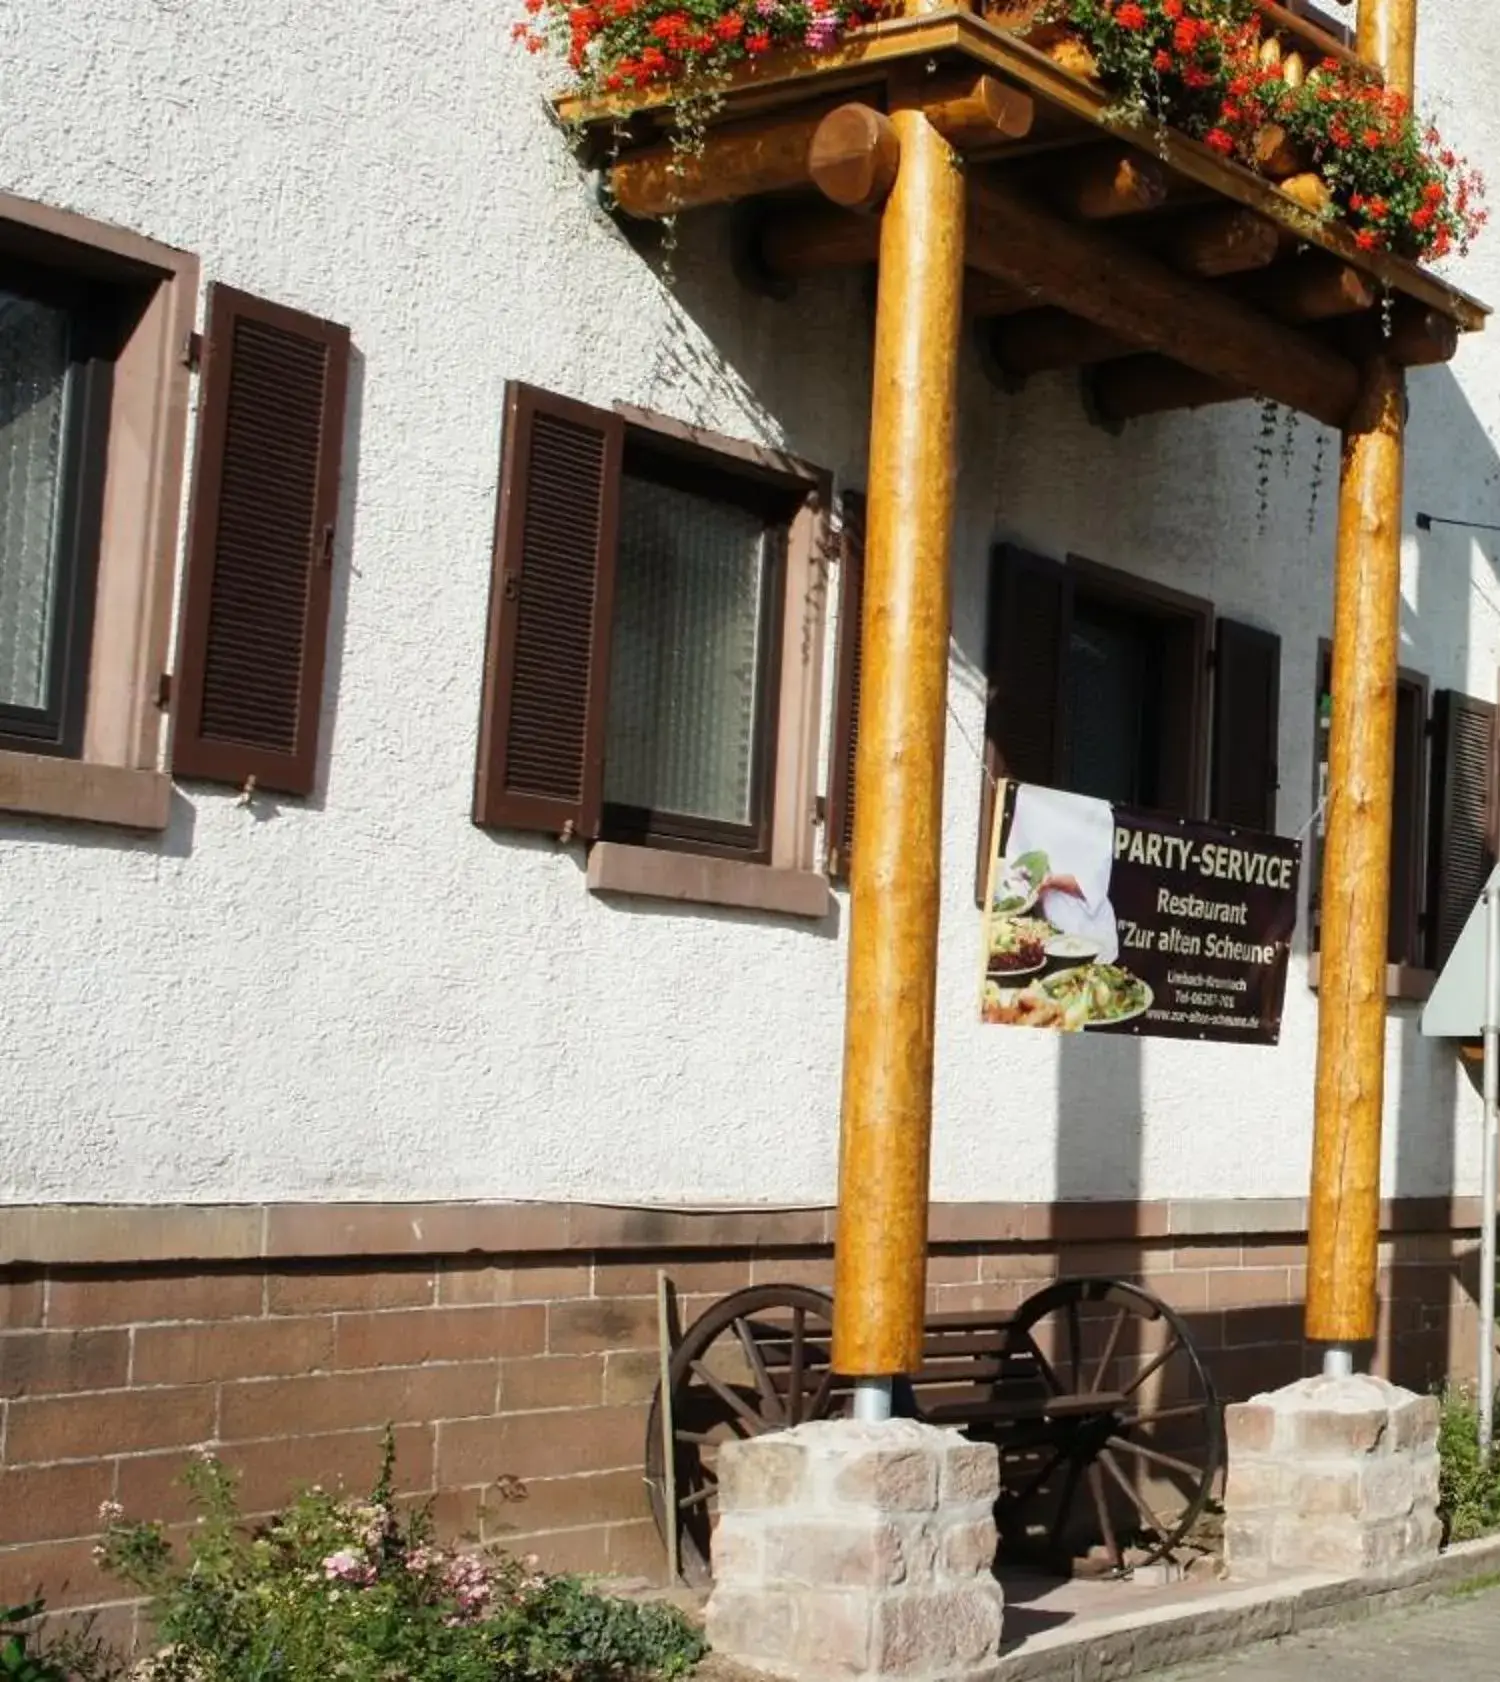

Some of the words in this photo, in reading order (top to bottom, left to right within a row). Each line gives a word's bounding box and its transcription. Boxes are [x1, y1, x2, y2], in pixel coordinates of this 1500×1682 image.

[1114, 827, 1293, 889] PARTY-SERVICE
[1157, 888, 1249, 925] Restaurant
[1158, 927, 1201, 955] alten
